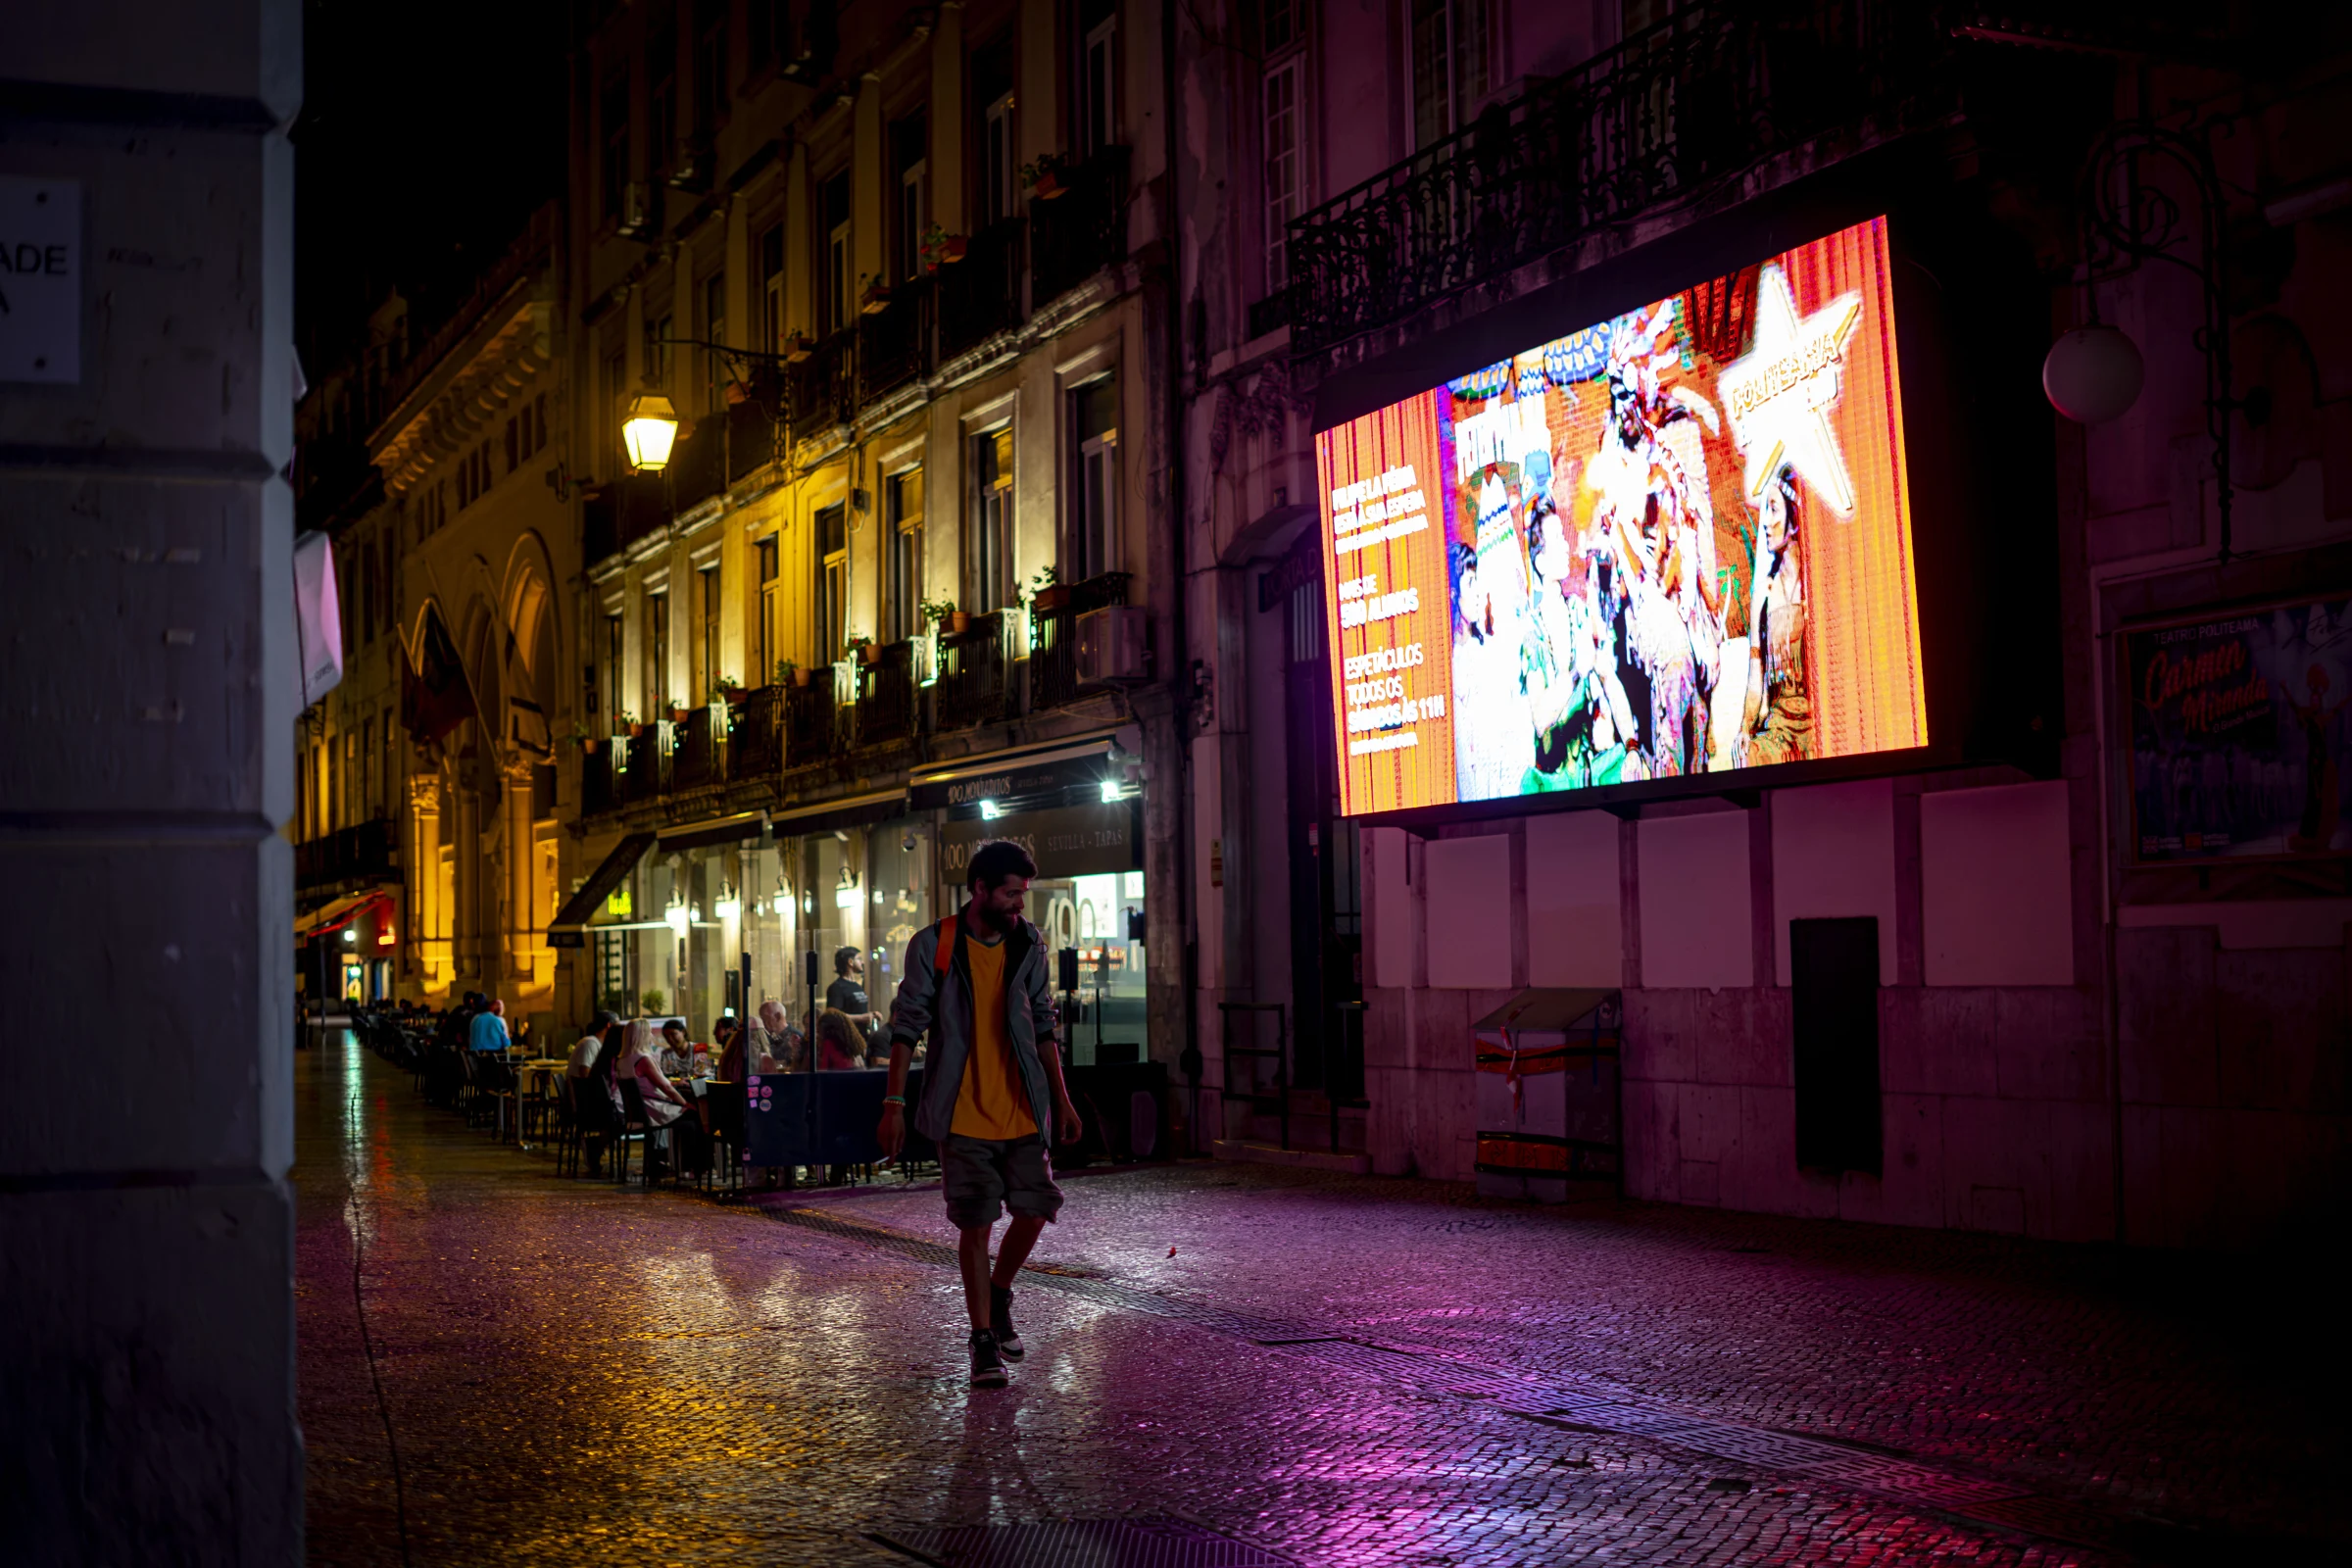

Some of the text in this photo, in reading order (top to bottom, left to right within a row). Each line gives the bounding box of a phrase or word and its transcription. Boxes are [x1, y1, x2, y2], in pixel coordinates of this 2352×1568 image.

[1362, 573, 1378, 595] DE
[2153, 615, 2260, 646] TEATRO POLITEAMA
[1345, 643, 1424, 680] ESPETÁCULOS
[2144, 640, 2247, 710] Carmen
[1346, 675, 1404, 706] TODOS OS
[2181, 662, 2270, 736] Miranda
[1418, 694, 1446, 719] 11H
[944, 843, 965, 870] 100
[1047, 834, 1085, 853] SEVILLA
[1095, 829, 1122, 848] TAPAS
[1043, 897, 1097, 953] 100
